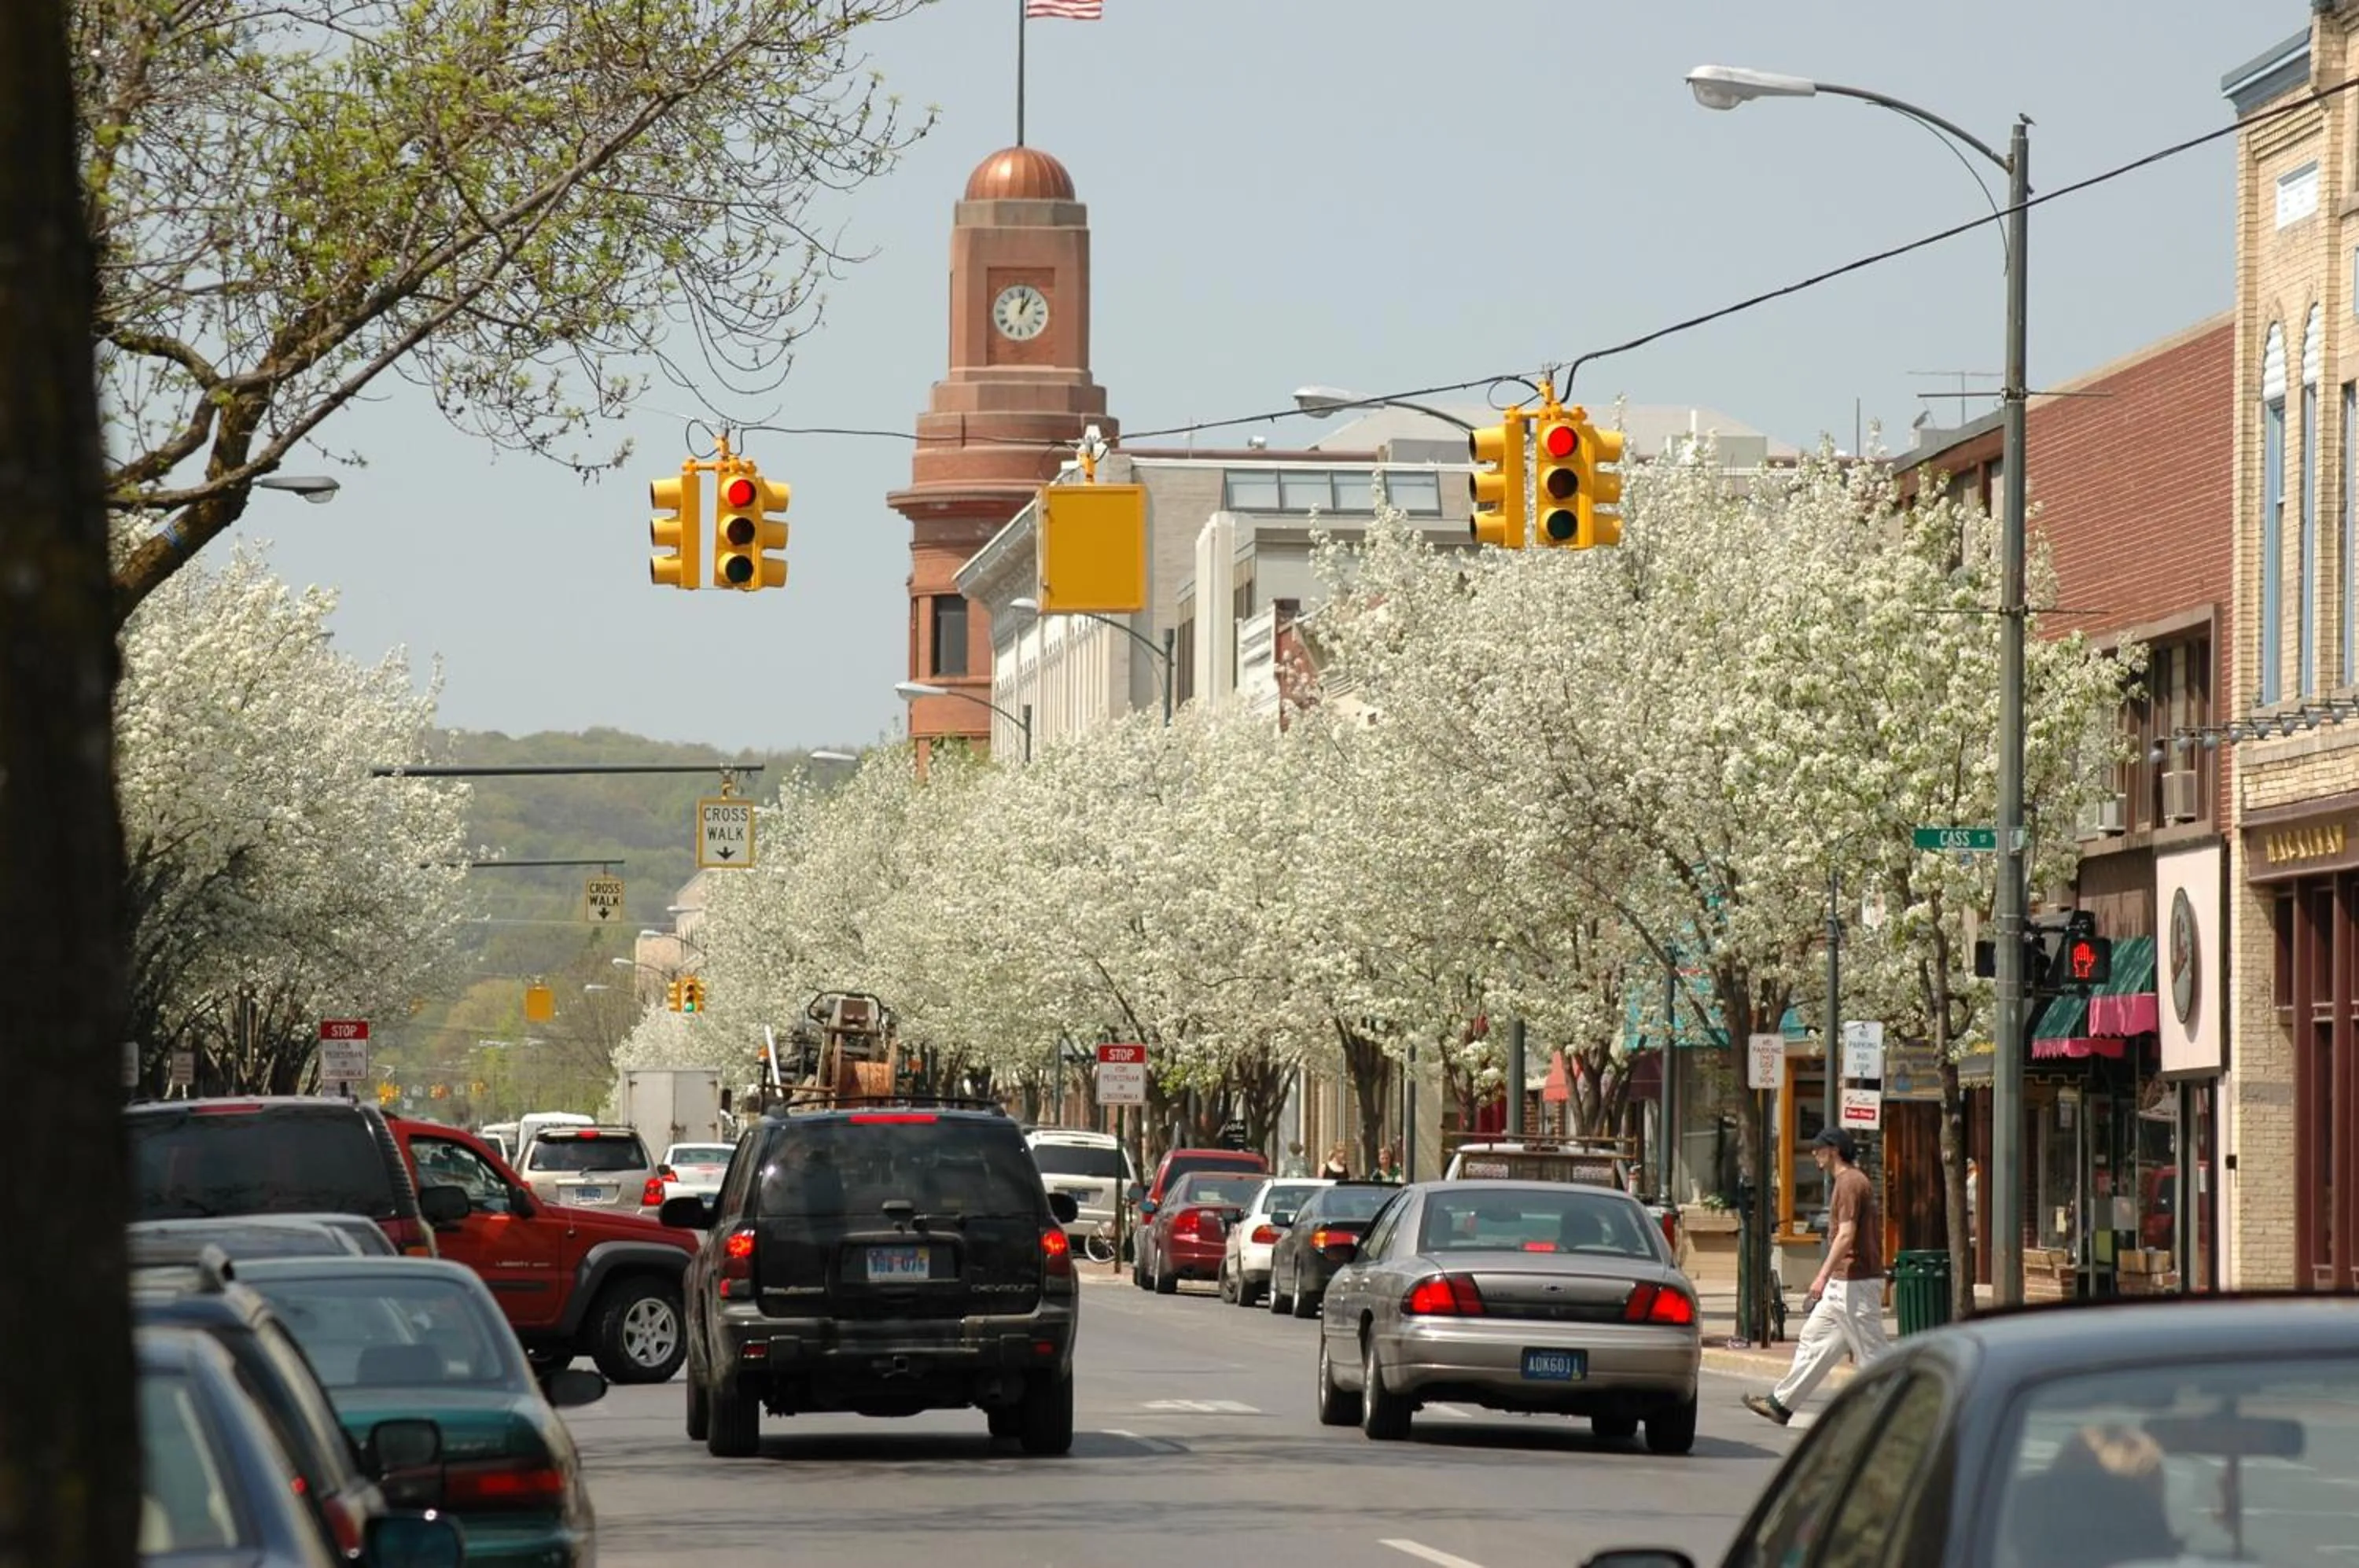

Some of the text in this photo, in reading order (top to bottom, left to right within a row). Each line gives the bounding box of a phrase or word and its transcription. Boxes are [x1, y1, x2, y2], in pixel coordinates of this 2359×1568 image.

[704, 807, 749, 822] CROSS
[707, 826, 744, 841] WALK
[1940, 830, 1971, 847] CASS
[590, 882, 620, 894] CROSS
[590, 895, 620, 907] WALK
[331, 1025, 358, 1037] STOP
[1109, 1048, 1135, 1061] STOP
